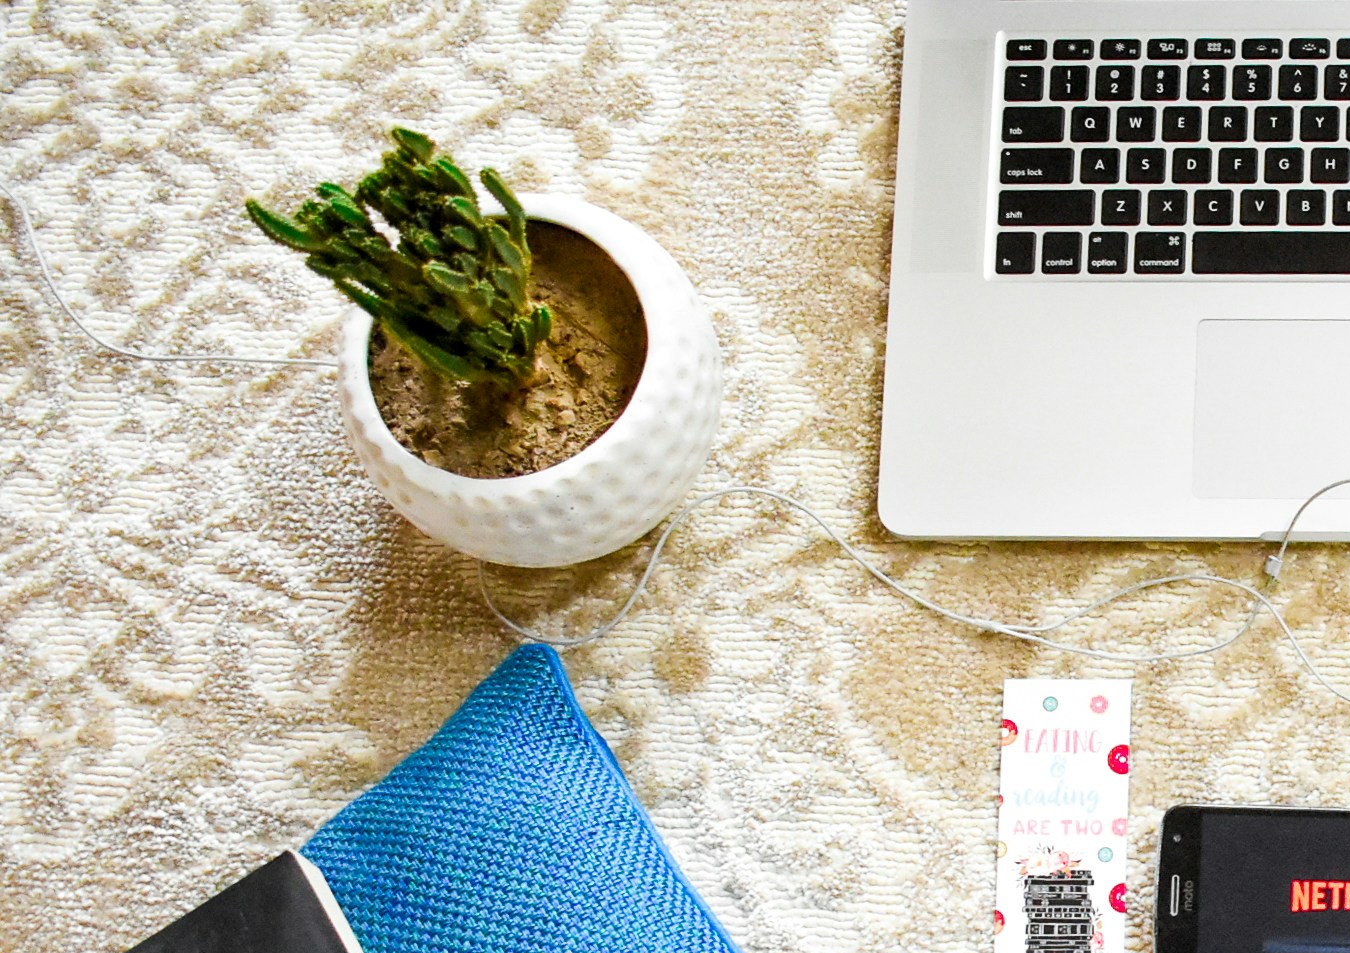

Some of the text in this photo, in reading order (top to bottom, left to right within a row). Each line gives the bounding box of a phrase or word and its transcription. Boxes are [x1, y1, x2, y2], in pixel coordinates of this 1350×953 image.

[1110, 82, 1119, 94] 2
[1156, 82, 1164, 94] 3
[1201, 82, 1210, 93] 4
[1247, 82, 1256, 93] 5
[1293, 82, 1302, 93] 6
[1339, 81, 1348, 93] 7
[1009, 126, 1023, 135] tab
[1084, 117, 1096, 130] Q
[1129, 117, 1143, 129] W
[1177, 116, 1185, 129] E
[1223, 116, 1233, 128] R
[1269, 116, 1278, 128] T
[1315, 116, 1325, 128] Y
[1006, 169, 1025, 178] caps
[1026, 167, 1043, 177] lock
[1094, 159, 1105, 170] A
[1141, 158, 1150, 170] S
[1186, 158, 1197, 170] D
[1234, 158, 1242, 170] F
[1278, 158, 1290, 170] G
[1325, 158, 1336, 170] H
[1005, 210, 1023, 219] shift
[1116, 200, 1126, 212] Z
[1162, 200, 1173, 212] X
[1208, 200, 1218, 212] C
[1254, 200, 1265, 212] V
[1301, 200, 1311, 212] B
[1002, 258, 1012, 266] fn
[1045, 258, 1074, 267] control
[1091, 258, 1117, 268] option
[1139, 258, 1180, 267] command
[1024, 728, 1103, 755] EATING
[1012, 780, 1102, 813] reading
[1012, 818, 1104, 836] ARE TWO
[1183, 880, 1194, 912] moto
